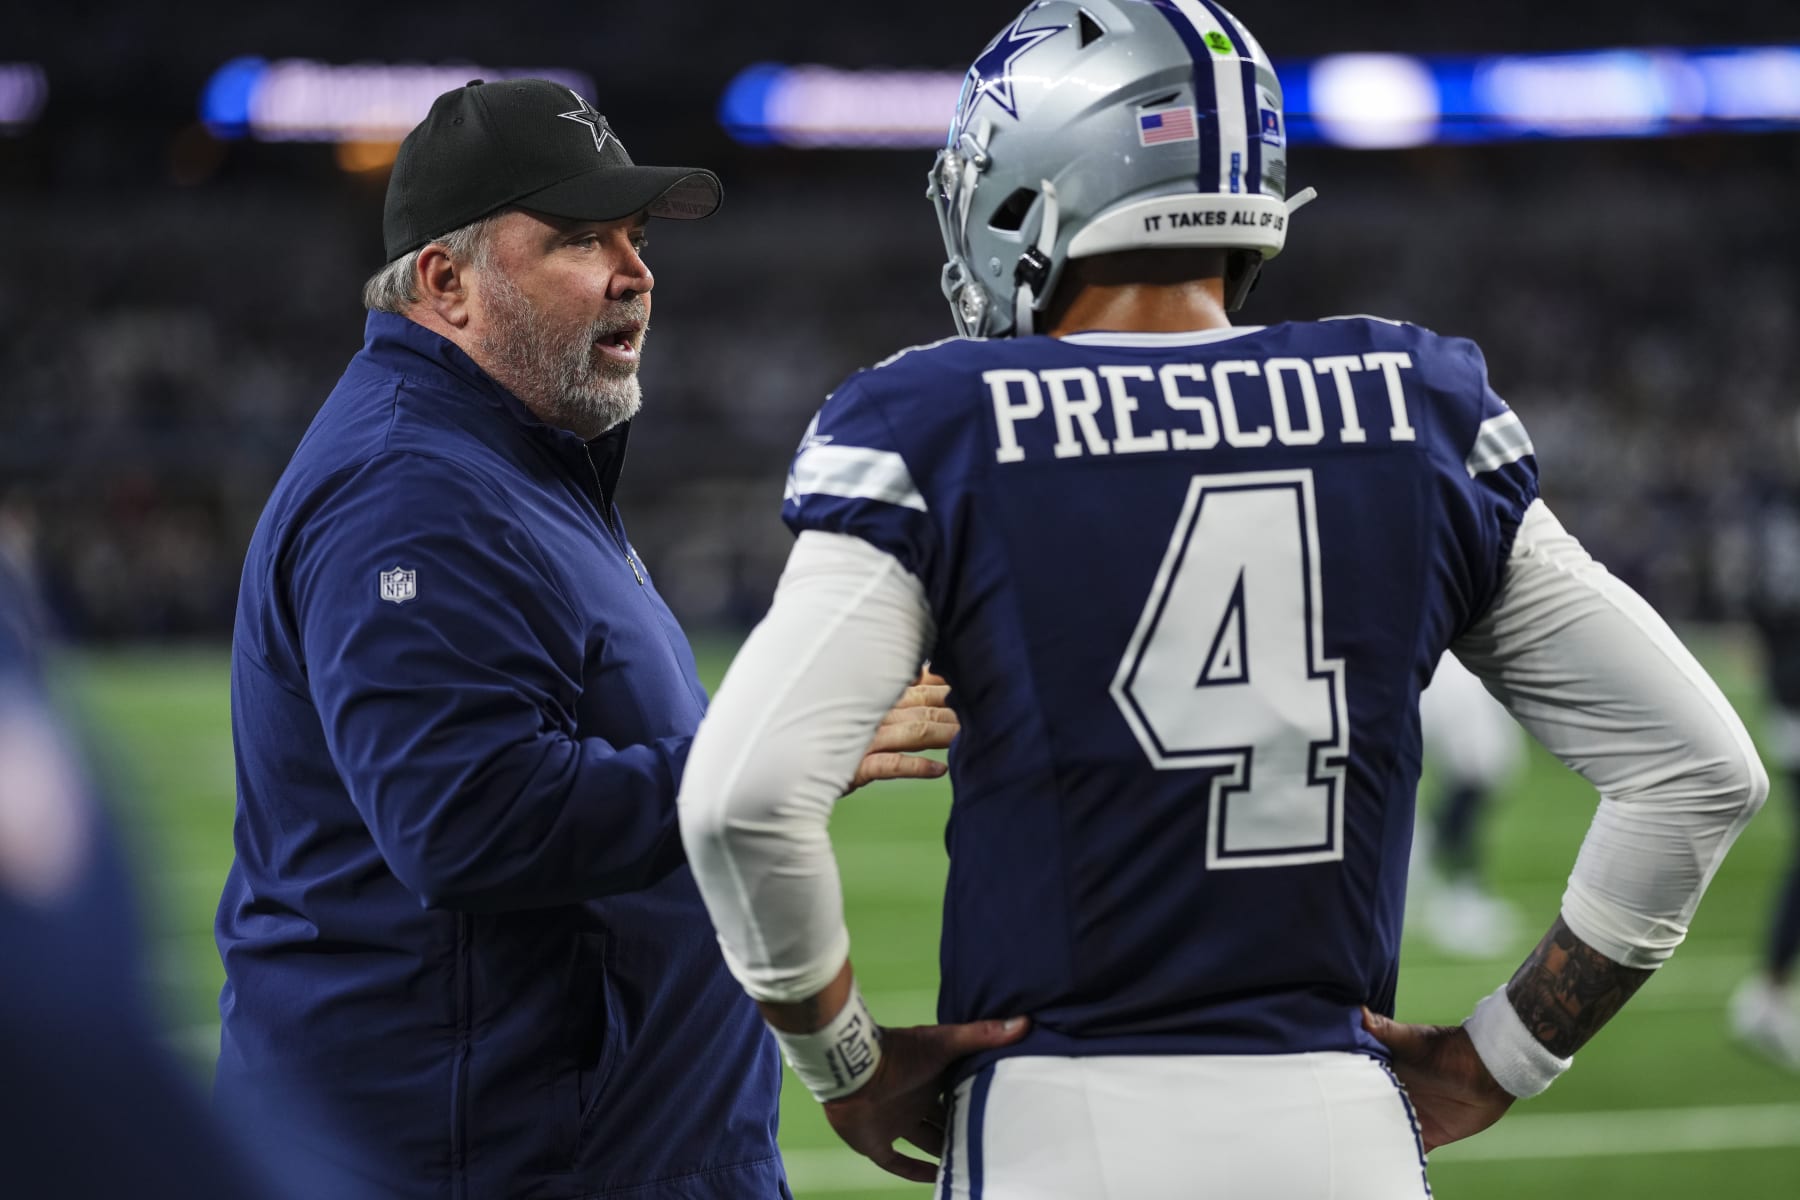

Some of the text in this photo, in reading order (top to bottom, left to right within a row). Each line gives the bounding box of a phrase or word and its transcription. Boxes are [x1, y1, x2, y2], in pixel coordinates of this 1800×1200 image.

[1144, 211, 1284, 232] IT TAKES ALL OF US
[982, 352, 1416, 464] PRESCOTT
[383, 582, 412, 598] NFL
[1109, 469, 1350, 870] 4
[837, 1012, 875, 1077] FAITH
